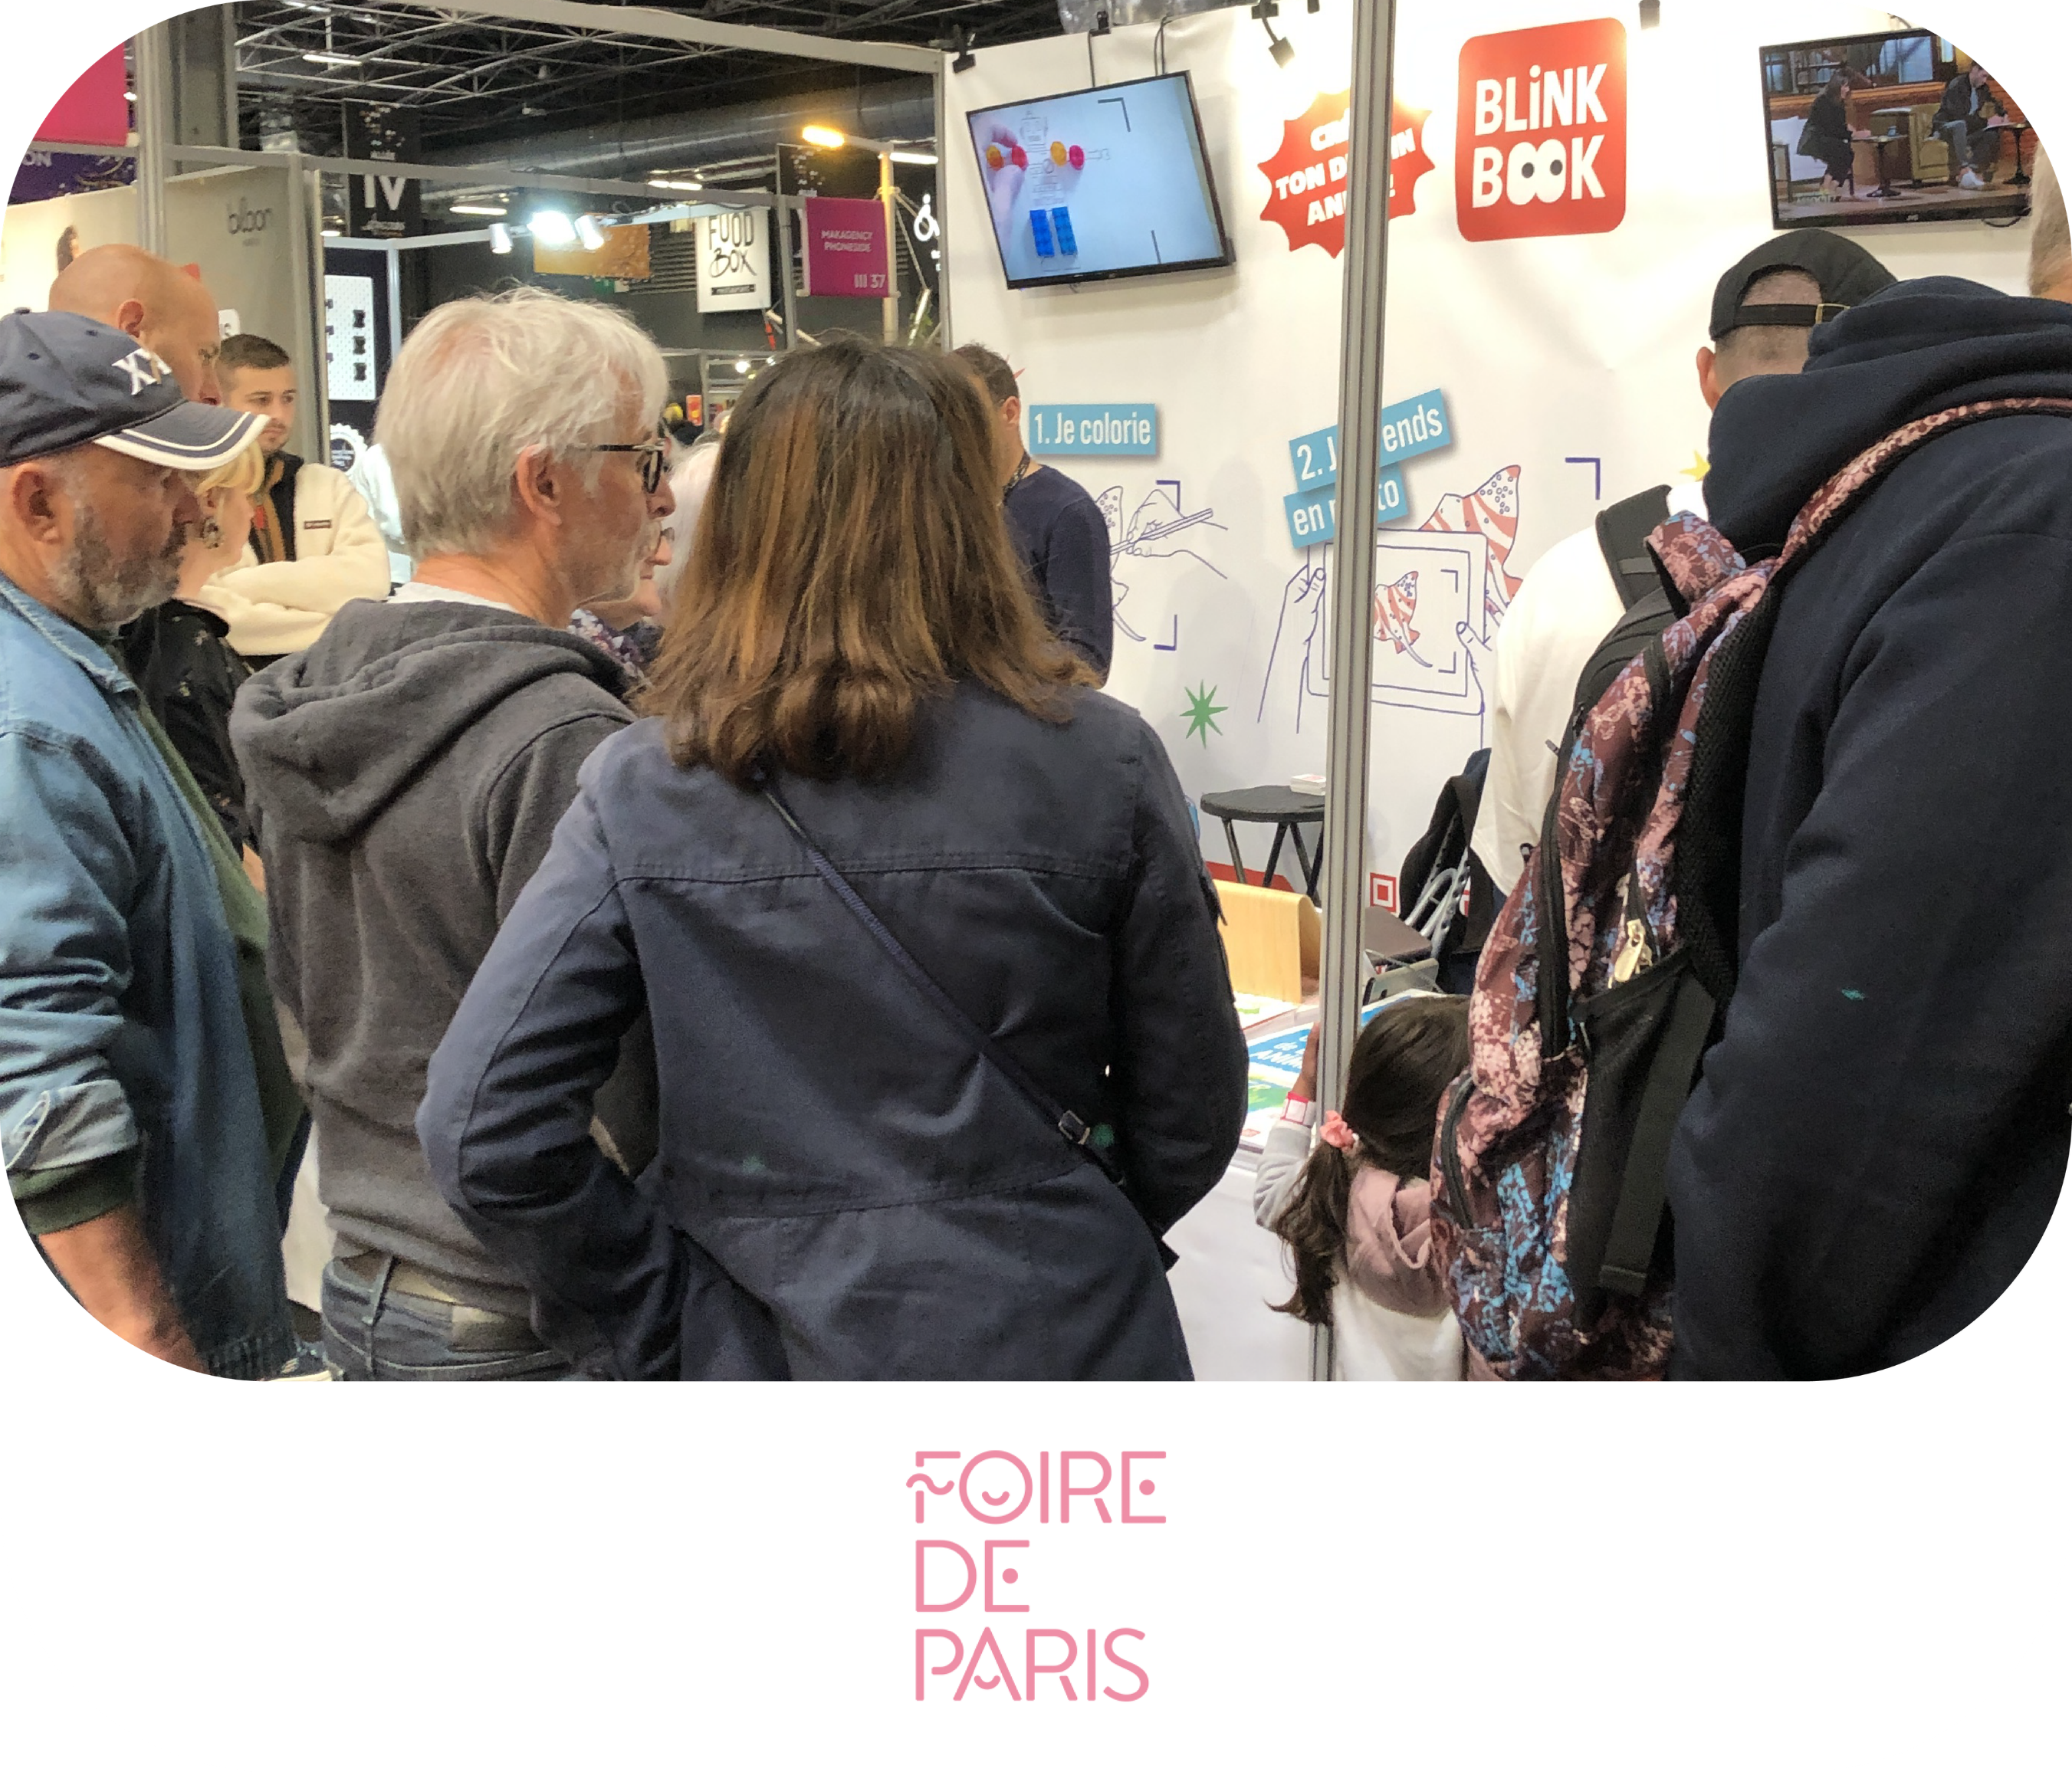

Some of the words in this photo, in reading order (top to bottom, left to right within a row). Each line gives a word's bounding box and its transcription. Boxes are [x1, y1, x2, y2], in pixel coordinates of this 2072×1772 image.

[1276, 162, 1326, 200] TON
[1472, 134, 1607, 208] BOOK
[363, 173, 406, 211] IV
[708, 247, 758, 278] BOX
[870, 274, 886, 289] 37
[1034, 412, 1050, 445] 1.
[1055, 412, 1075, 445] Je
[1080, 412, 1151, 445] colorie
[1297, 444, 1323, 481] 2.
[1382, 403, 1443, 452] ends
[1292, 502, 1325, 536] en
